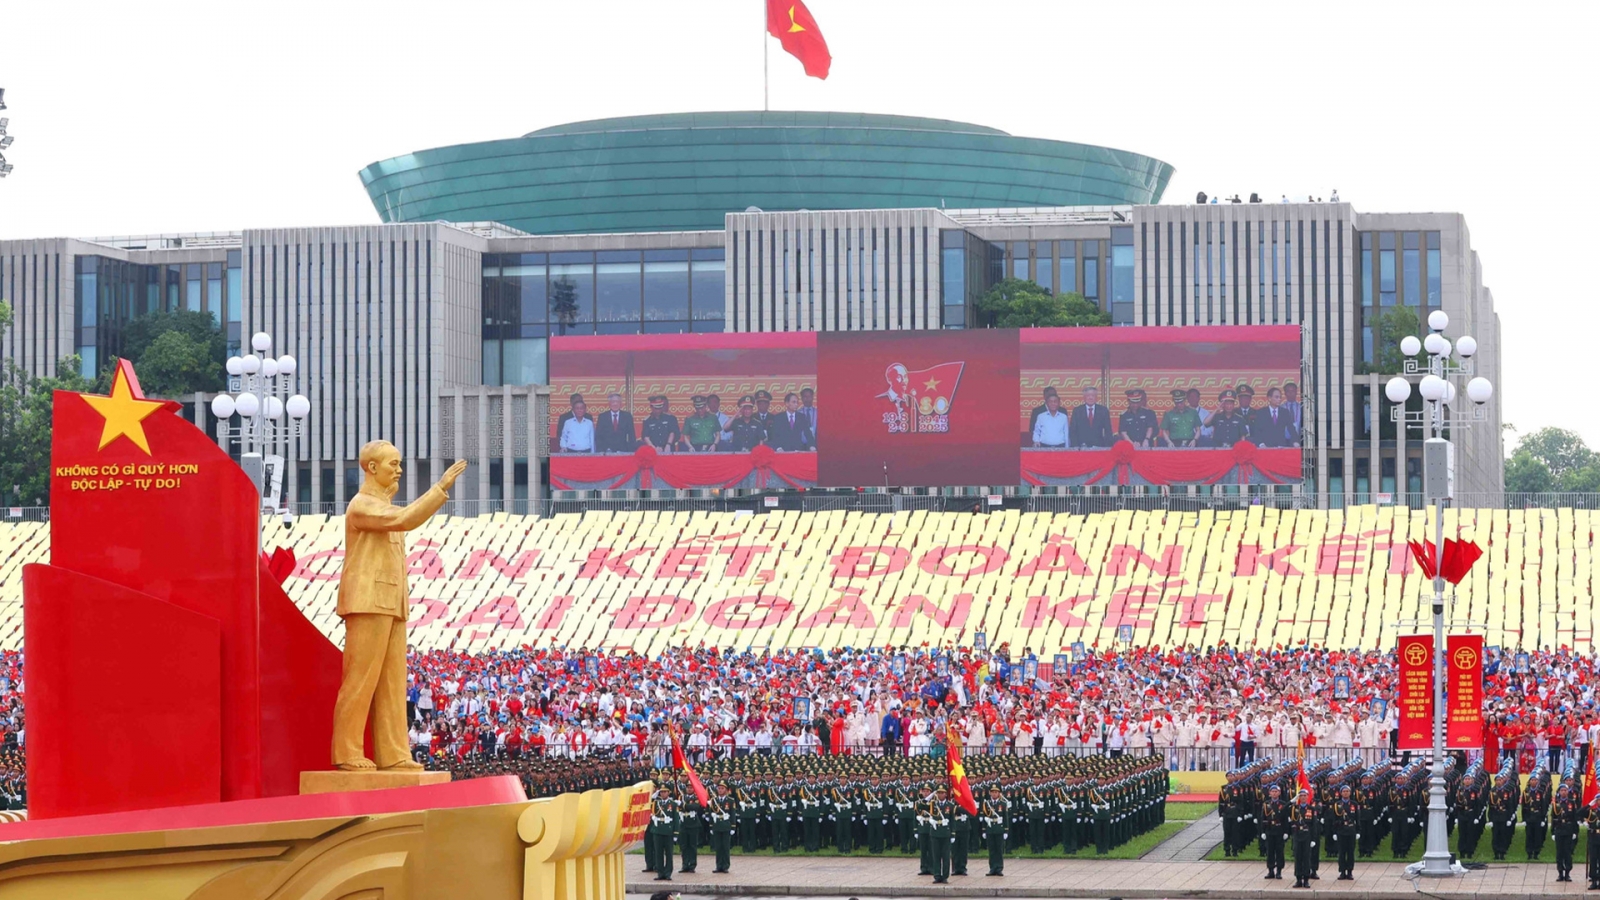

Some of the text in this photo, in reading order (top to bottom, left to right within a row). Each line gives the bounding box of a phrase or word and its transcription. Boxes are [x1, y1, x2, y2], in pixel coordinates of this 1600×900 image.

[920, 396, 949, 415] 80
[919, 415, 949, 424] 1945
[919, 423, 949, 432] 2025
[56, 463, 199, 476] KHÔNG CÓ GÌ QUÝ HƠN
[71, 478, 97, 491] ĐỘC
[99, 478, 124, 491] LẬP
[134, 479, 152, 491] TỰ
[829, 533, 1184, 579] ĐOÀN
[1231, 529, 1415, 577] KẾT
[609, 585, 974, 630] ĐOÀN
[1020, 579, 1224, 629] KẾT
